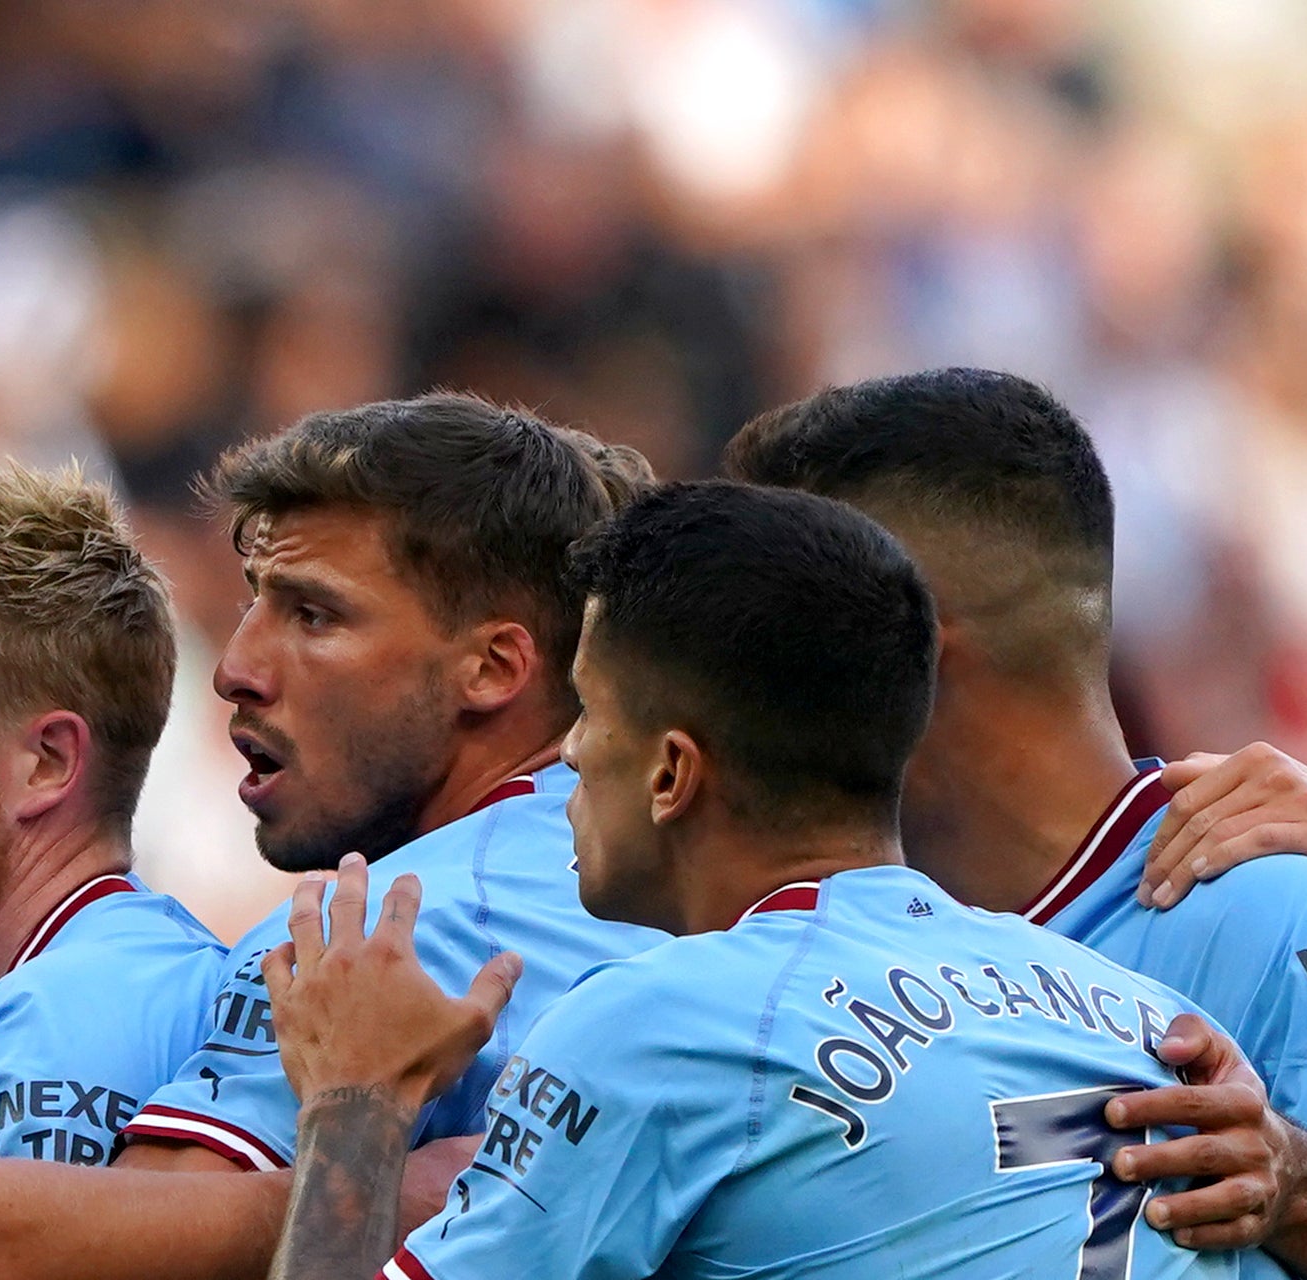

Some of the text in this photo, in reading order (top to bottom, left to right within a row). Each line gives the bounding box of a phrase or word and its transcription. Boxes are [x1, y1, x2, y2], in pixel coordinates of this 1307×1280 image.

[788, 961, 1188, 1149] JOÃO CANCE
[21, 1128, 115, 1167] TIR
[483, 1107, 543, 1177] RE
